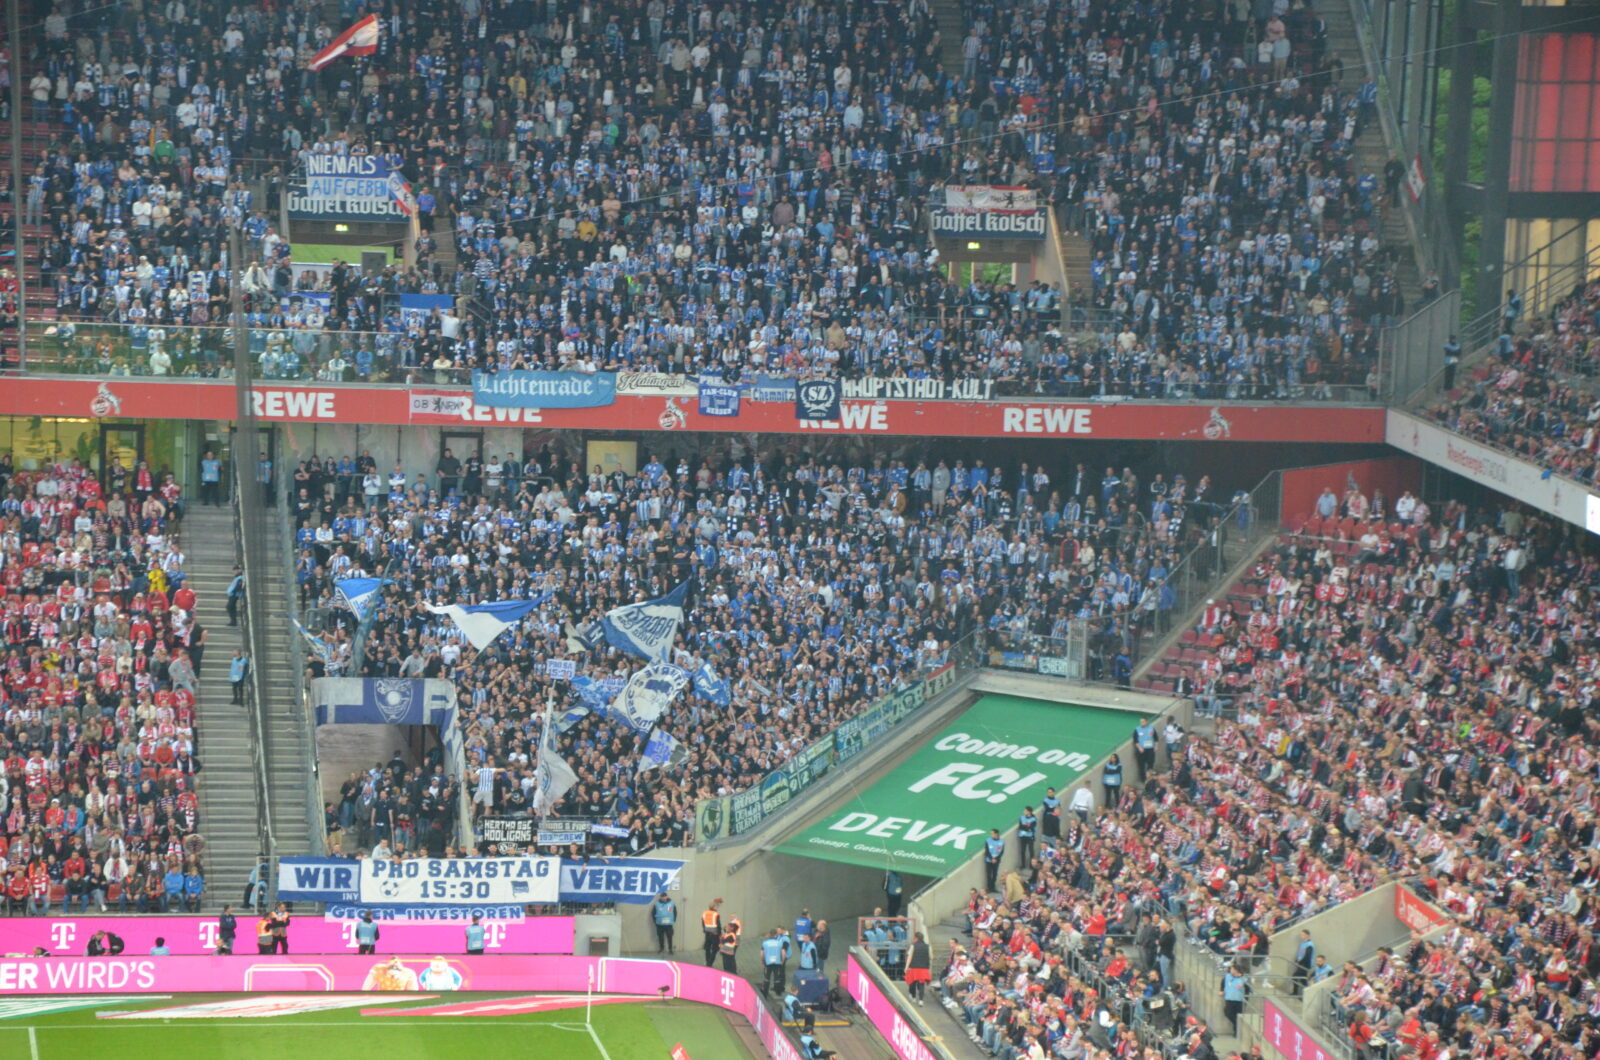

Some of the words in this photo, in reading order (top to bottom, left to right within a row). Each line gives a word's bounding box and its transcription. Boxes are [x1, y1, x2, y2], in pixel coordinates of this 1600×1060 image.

[308, 154, 377, 175] NIEMALS
[311, 179, 387, 197] AUFGEBEN
[477, 372, 593, 398] Lichtenrade
[247, 391, 335, 418] REWE
[1003, 408, 1092, 434] REWE
[934, 732, 1039, 760] Come
[1036, 749, 1092, 772] on,
[907, 762, 1047, 804] FC!
[484, 819, 516, 830] HERTHA
[484, 829, 532, 842] HOOLIGANS
[829, 812, 986, 850] DEVK
[294, 867, 353, 889] WIR
[372, 860, 420, 879] PRO
[427, 860, 550, 879] SAMSTAG
[569, 868, 669, 893] VEREIN
[420, 880, 491, 899] 15:30
[406, 905, 522, 921] INVESTOREN
